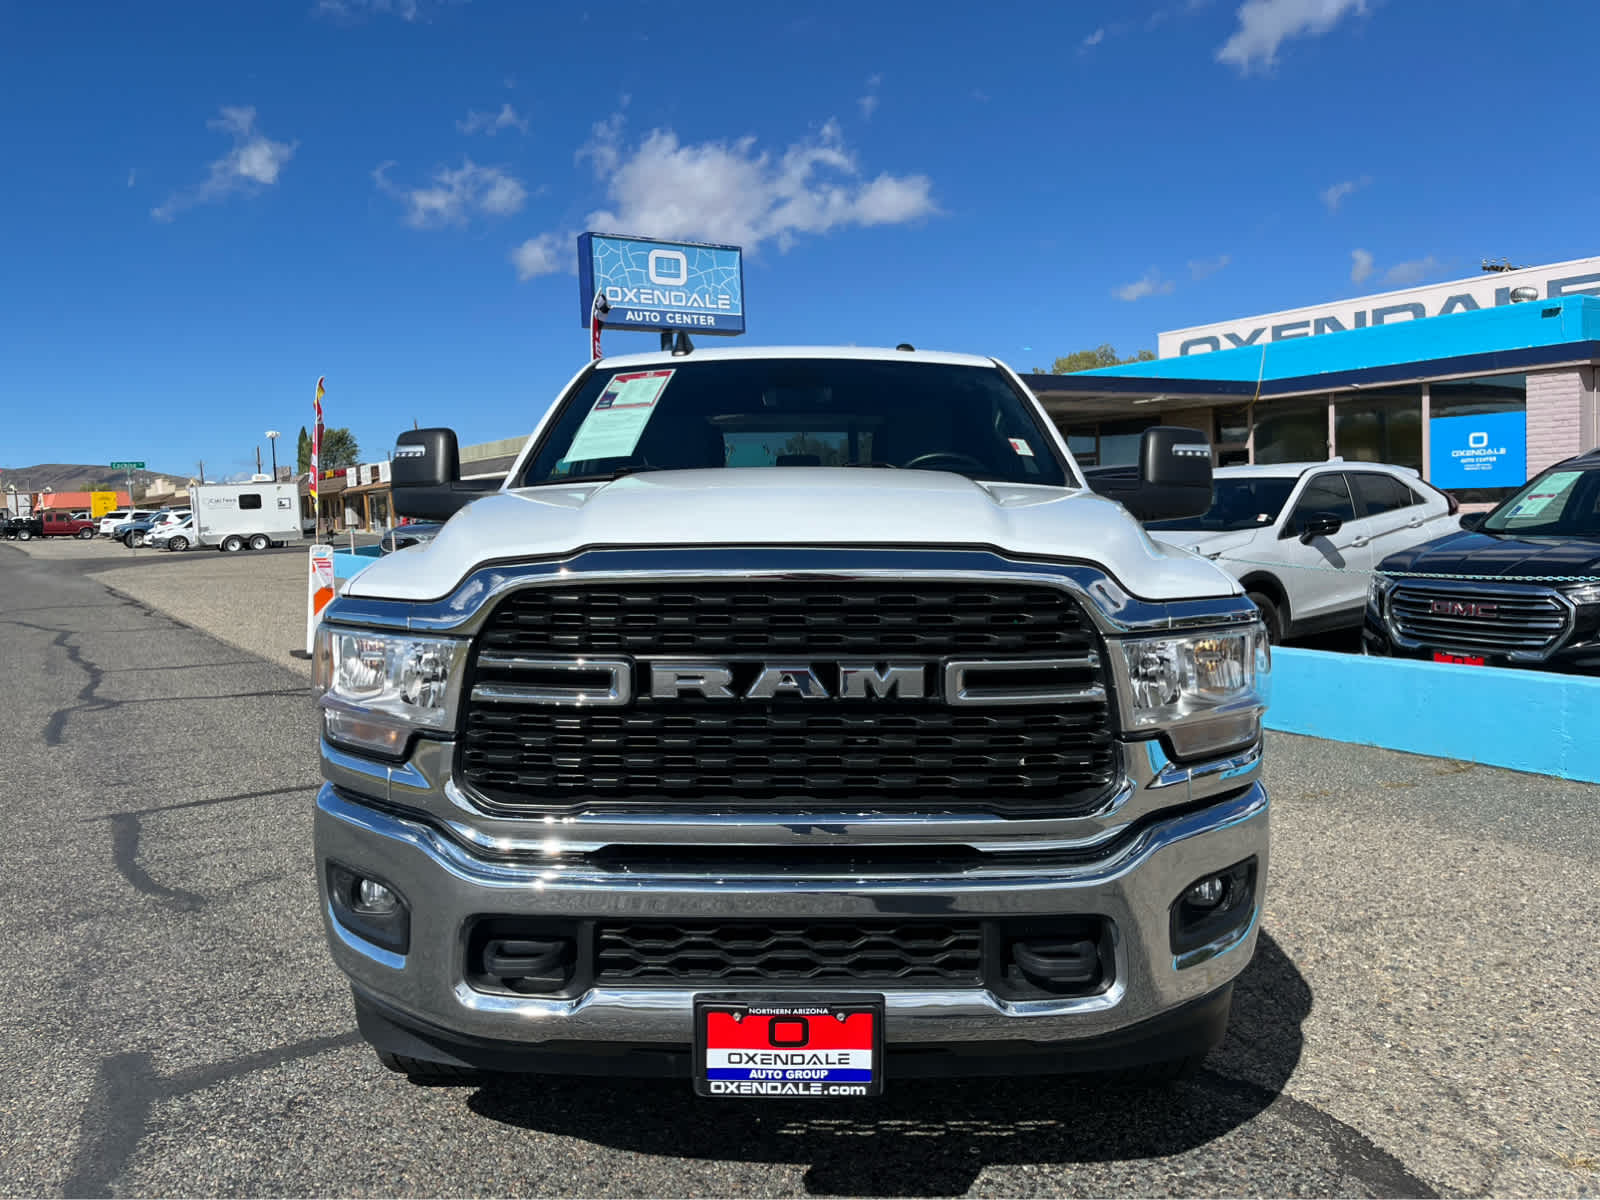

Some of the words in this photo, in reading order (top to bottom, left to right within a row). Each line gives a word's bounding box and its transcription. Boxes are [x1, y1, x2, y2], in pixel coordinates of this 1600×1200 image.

[605, 286, 731, 310] OXENDALE
[625, 311, 661, 323] AUTO
[665, 313, 716, 326] CENTER
[1430, 601, 1497, 618] GMC
[650, 665, 925, 699] RAM
[748, 1007, 791, 1015] NORTHERN
[792, 1007, 829, 1015] ARIZONA
[728, 1052, 851, 1066] OXENDALE
[748, 1069, 783, 1080] AUTO
[785, 1069, 829, 1080] GROUP
[710, 1081, 867, 1096] OXENDALE.com
